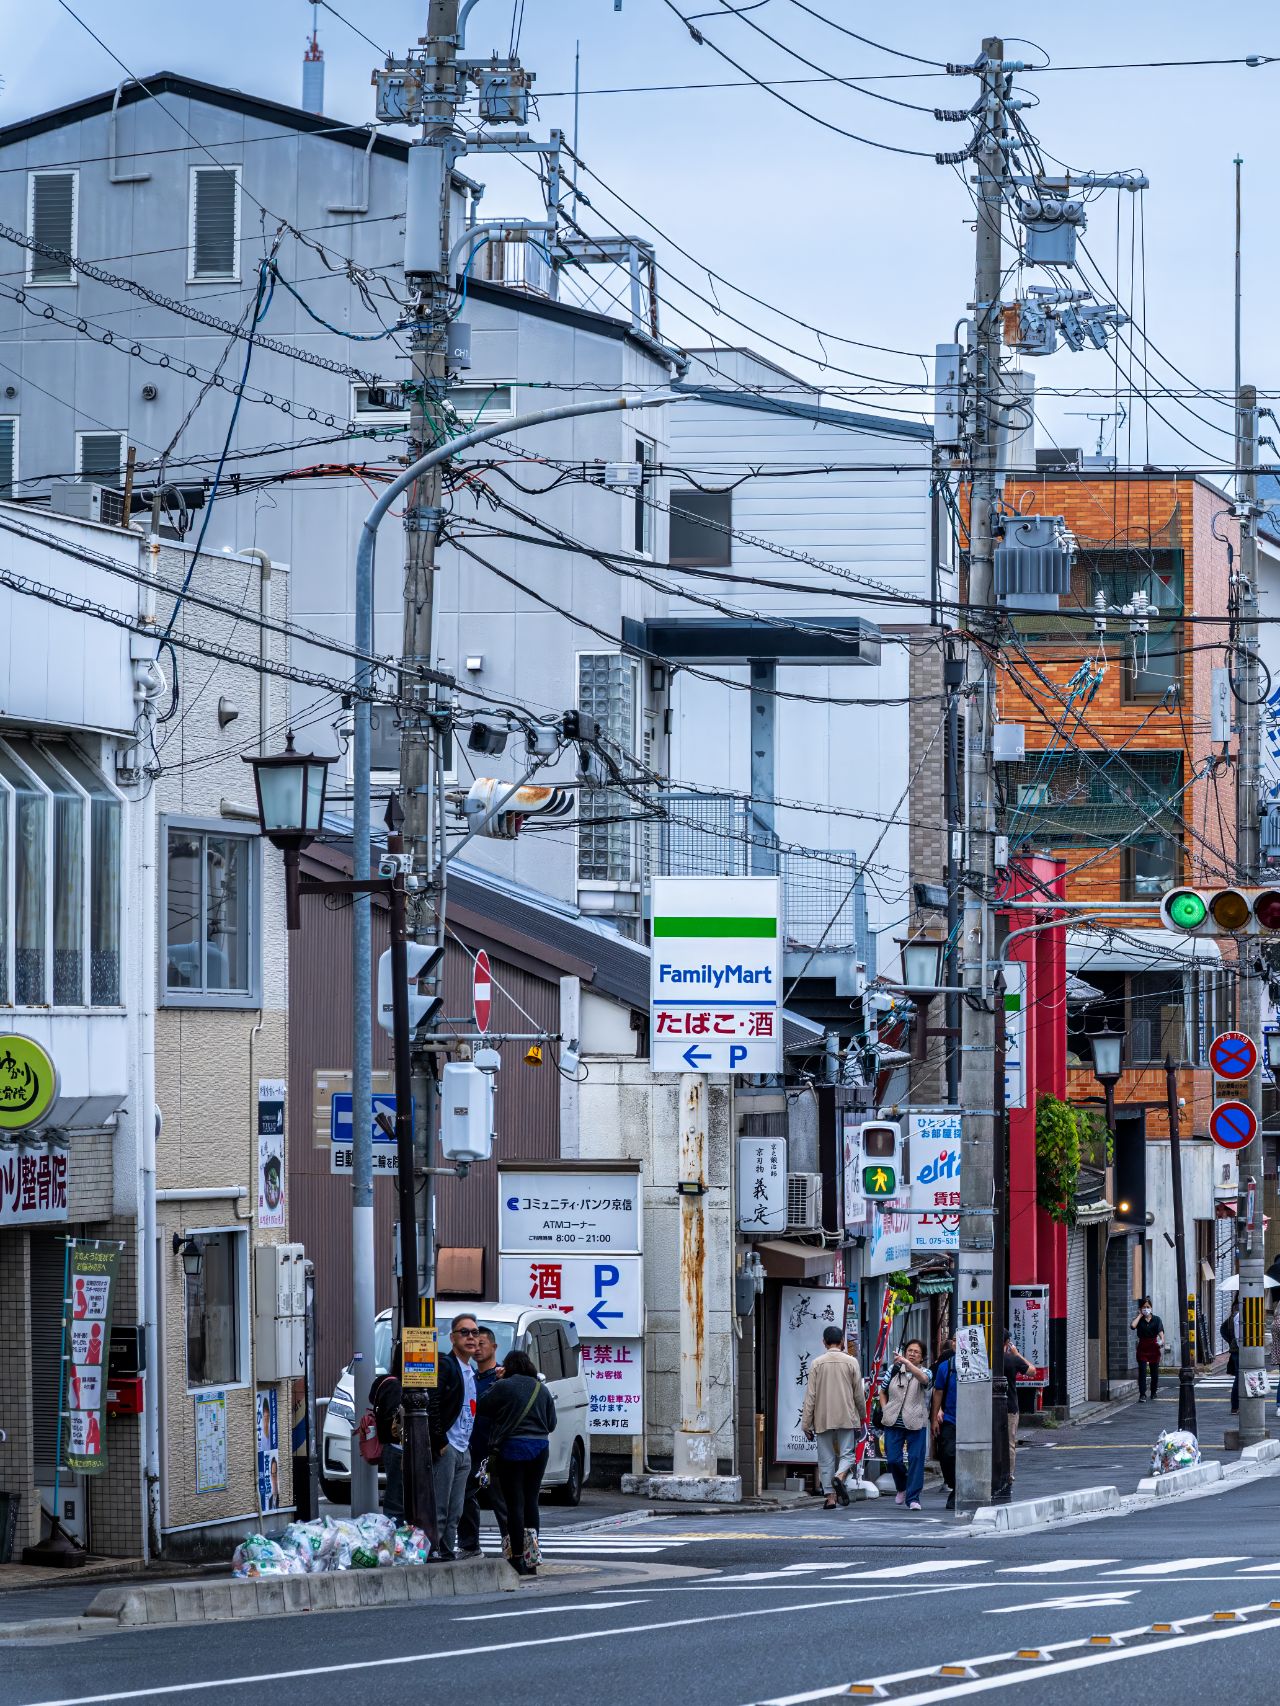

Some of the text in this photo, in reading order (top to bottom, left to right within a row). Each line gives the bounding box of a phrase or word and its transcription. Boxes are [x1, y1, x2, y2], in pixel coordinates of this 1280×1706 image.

[659, 964, 772, 988] FamilyMart
[656, 1012, 774, 1037] たばこ・酒
[729, 1046, 747, 1068] P
[917, 1118, 961, 1127] ひとつ上
[916, 1149, 961, 1184] elit
[522, 1199, 632, 1211] コミュニティ・バンク京信
[543, 1221, 596, 1229] ATMコーナー
[556, 1234, 576, 1242] 8:00
[586, 1234, 611, 1242] 21:00
[529, 1263, 563, 1300] 酒
[594, 1264, 620, 1298] P
[590, 1404, 628, 1412] 受けます。
[589, 1419, 629, 1428] 条本町店
